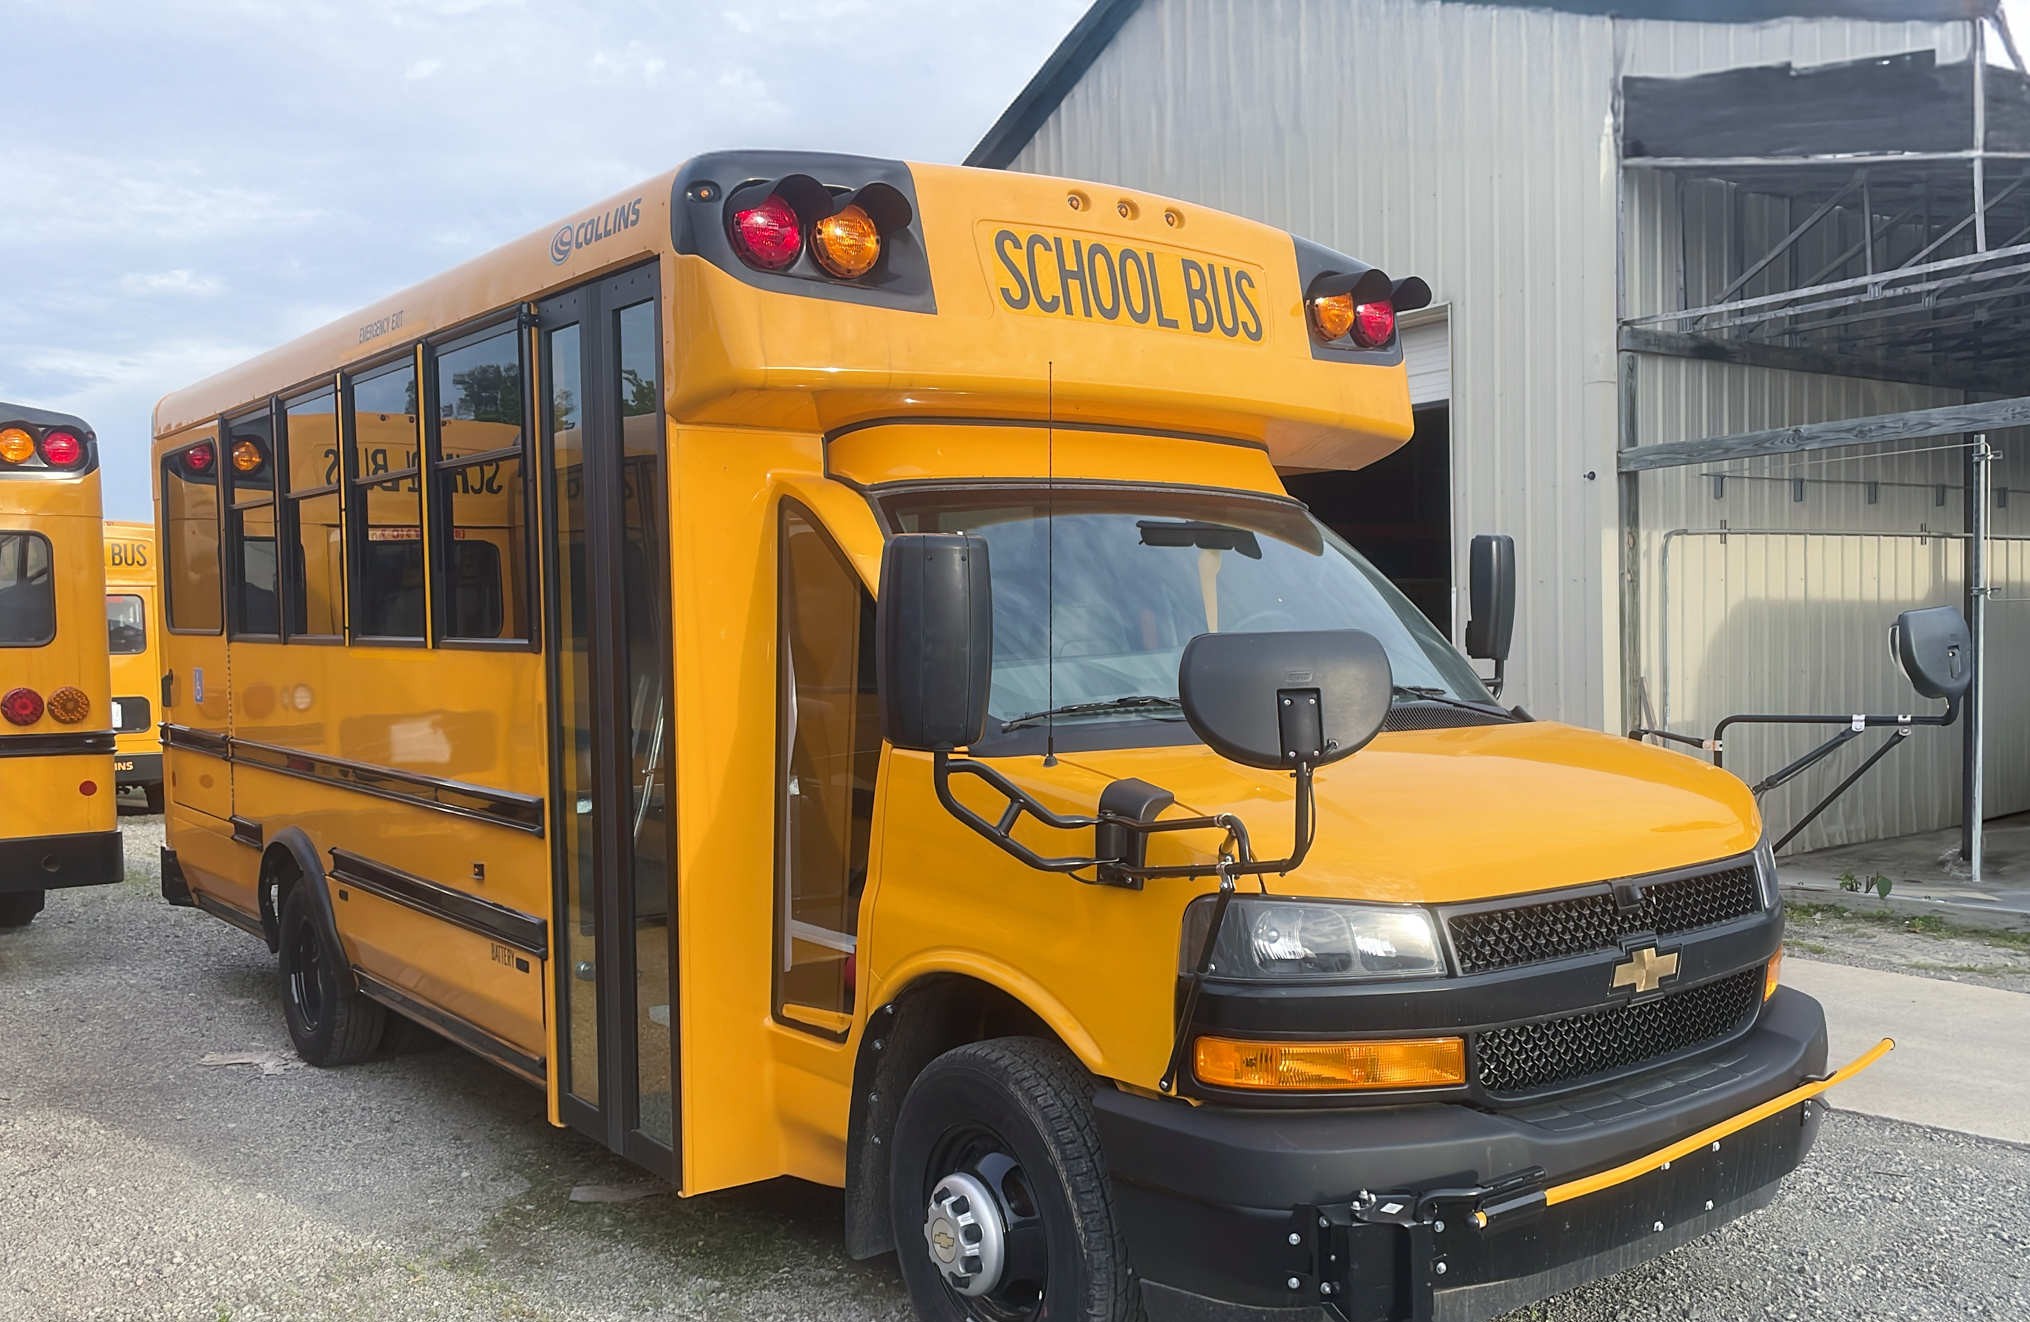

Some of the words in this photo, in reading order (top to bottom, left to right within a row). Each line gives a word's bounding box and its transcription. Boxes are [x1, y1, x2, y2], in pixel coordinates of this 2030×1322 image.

[574, 197, 642, 250] COLLINS
[993, 229, 1180, 330] SCHOOL
[1181, 257, 1263, 342] BUS
[359, 317, 391, 344] EMERGENCY
[391, 310, 404, 330] EXIT
[111, 543, 148, 567] BUS
